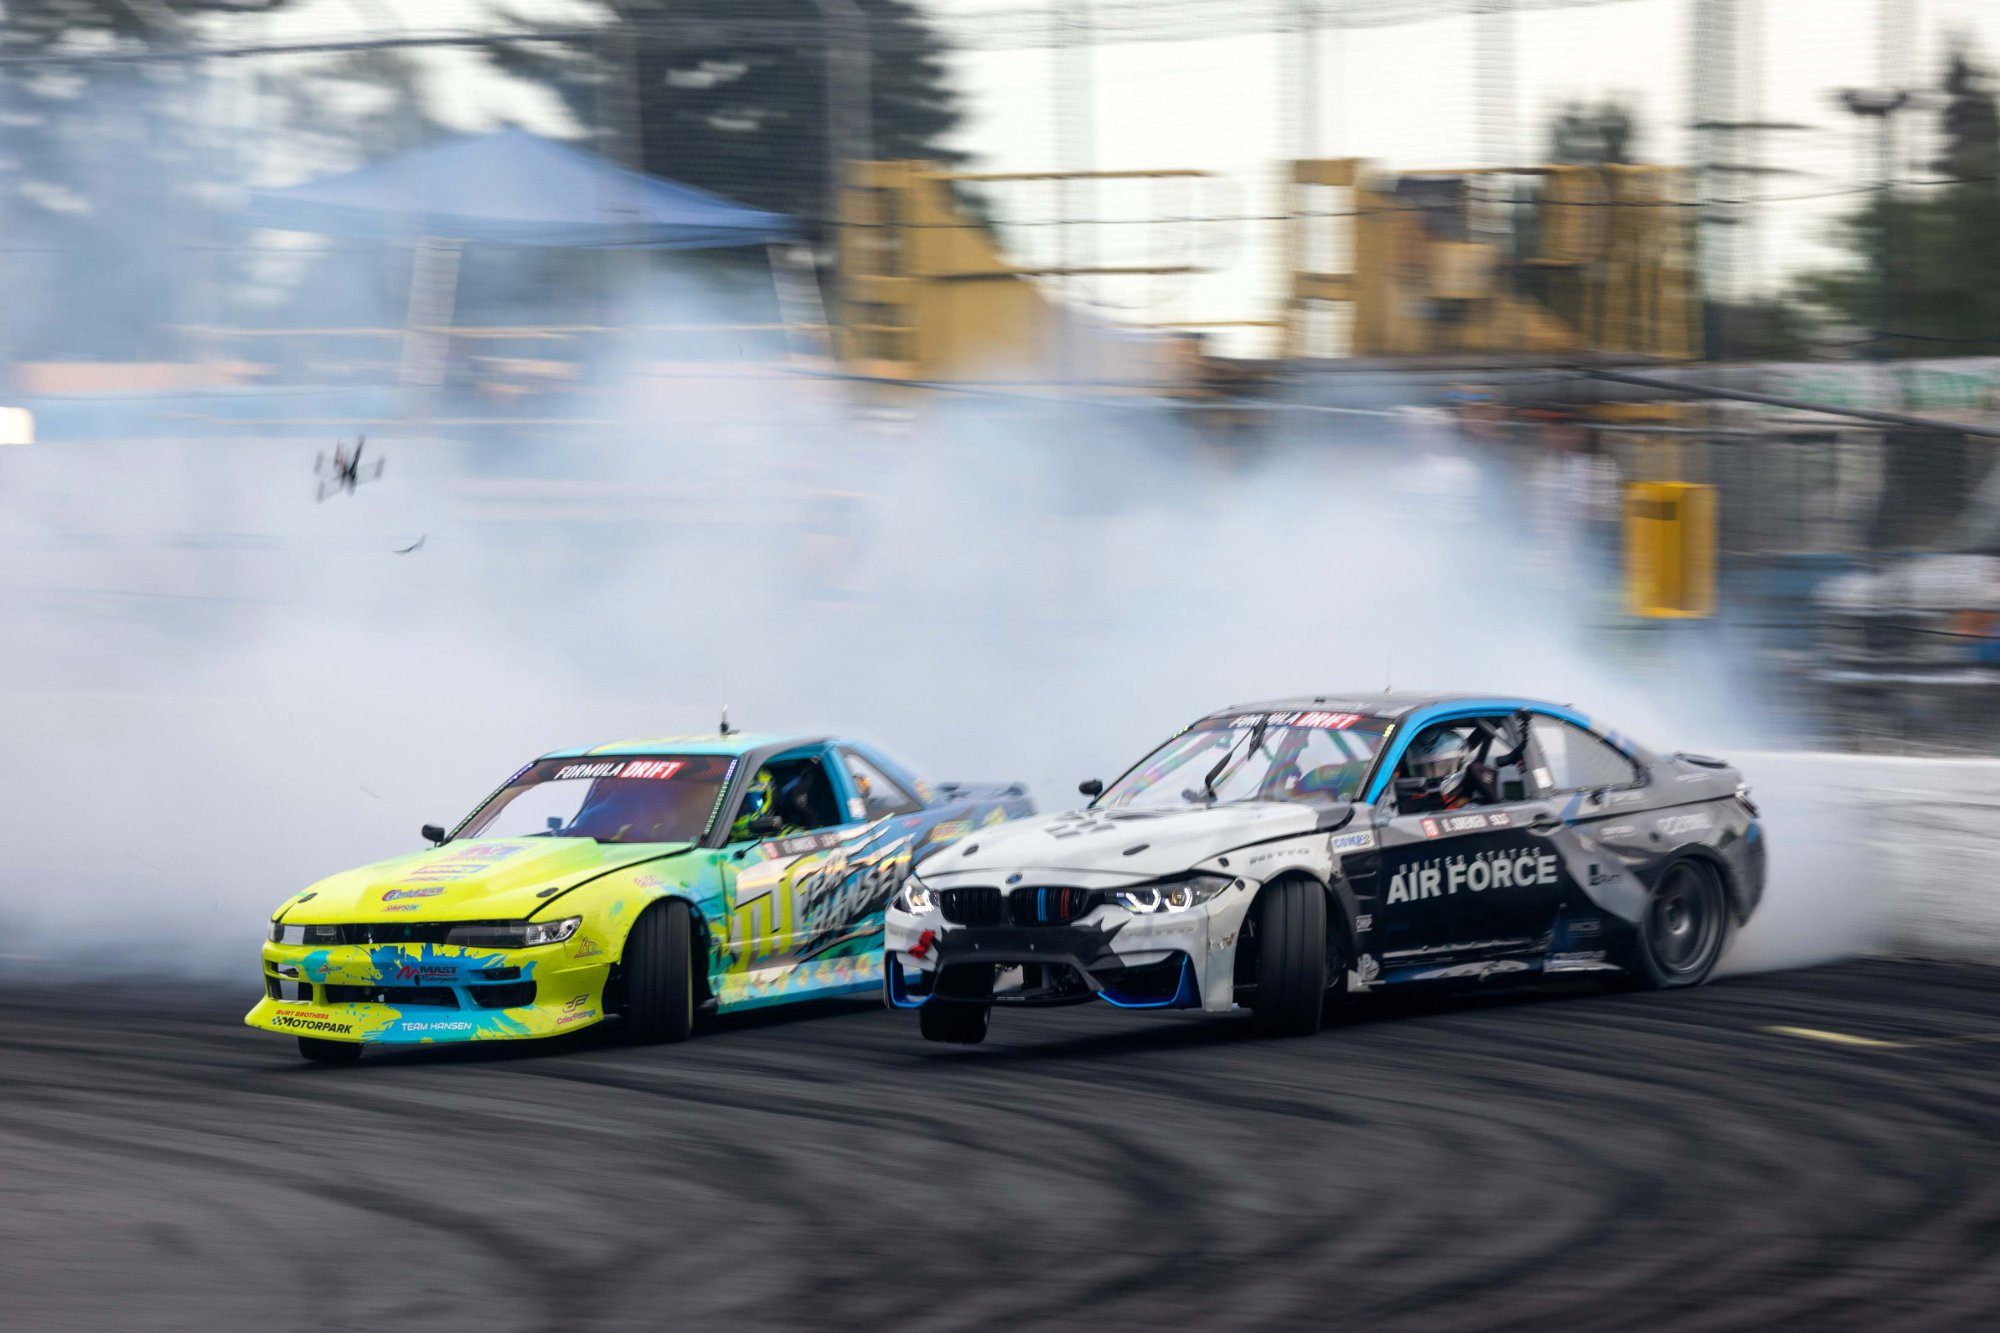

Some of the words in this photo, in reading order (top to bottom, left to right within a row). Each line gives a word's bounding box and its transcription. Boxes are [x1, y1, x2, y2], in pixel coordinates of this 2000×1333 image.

[1295, 710, 1360, 729] DRIFT
[553, 762, 626, 780] FORMULA
[619, 761, 681, 779] DRIFT
[1399, 854, 1466, 875] UNITED
[1475, 846, 1541, 863] STATES
[1386, 867, 1443, 905] AIR
[1447, 854, 1559, 895] FORCE
[419, 966, 458, 975] MAST
[295, 1010, 330, 1020] BROTHERS
[280, 1016, 353, 1034] MOTORPARK
[401, 1022, 428, 1031] TEAM
[429, 1022, 473, 1031] HANSEN
